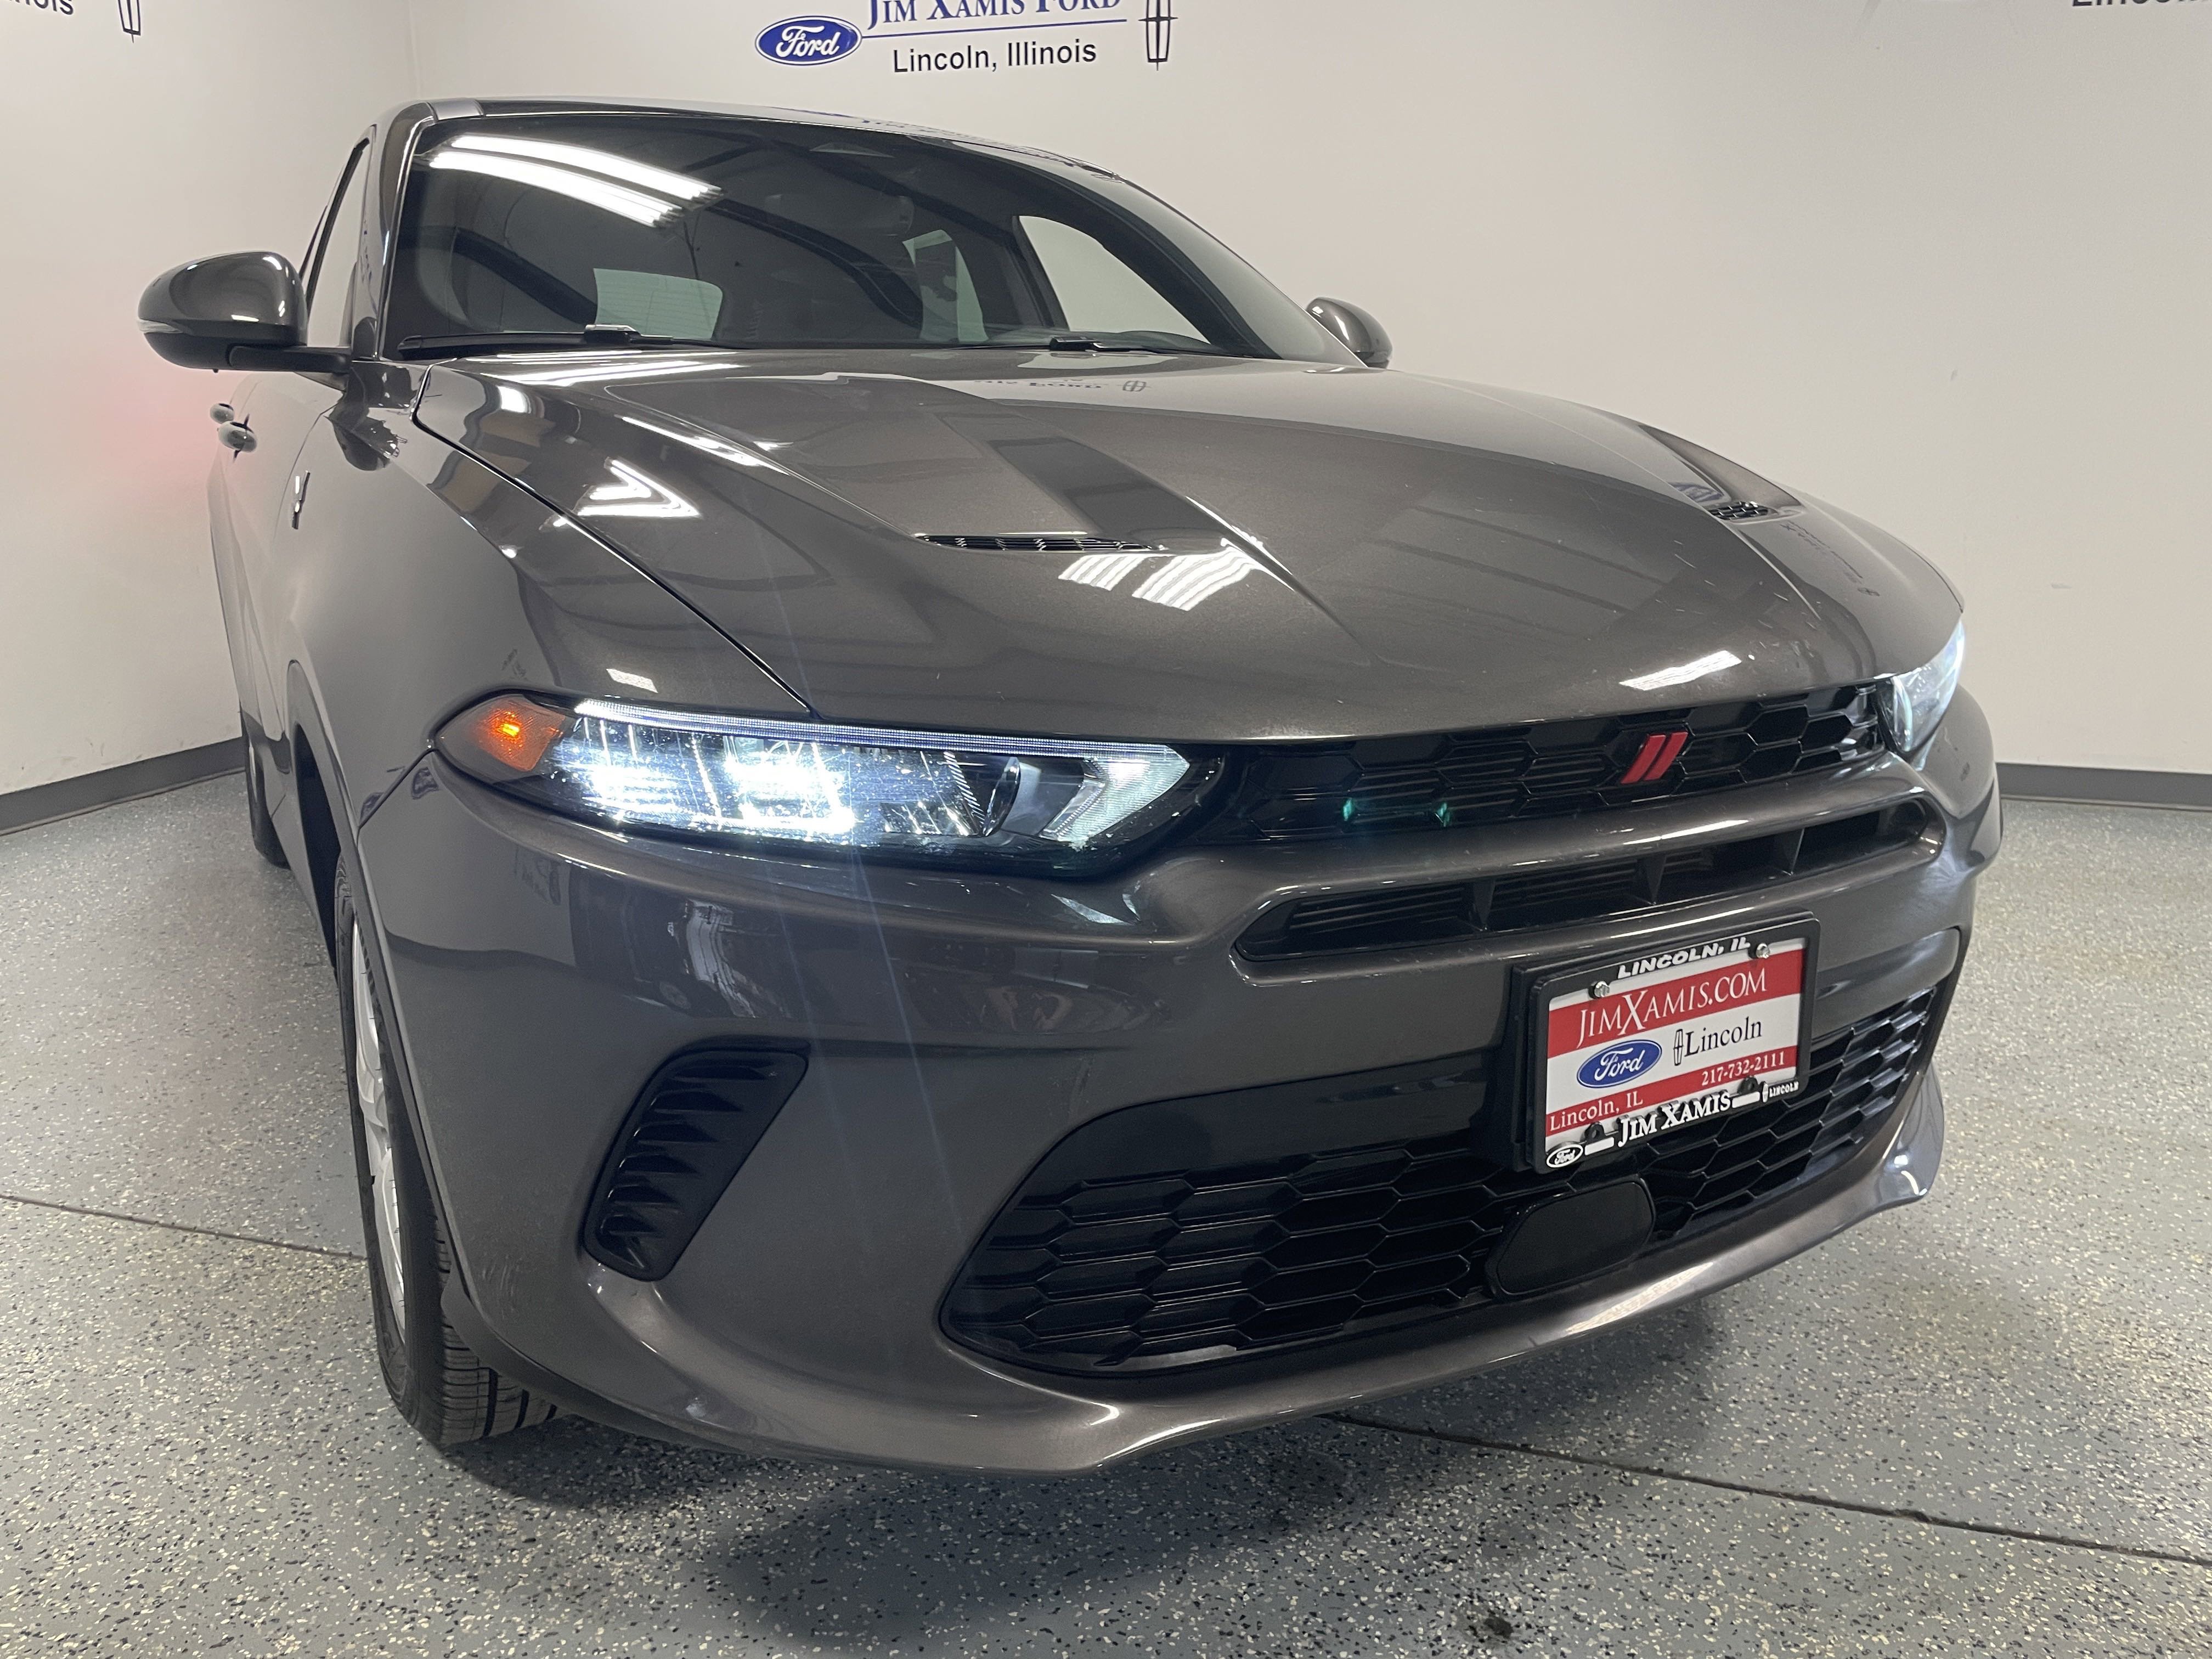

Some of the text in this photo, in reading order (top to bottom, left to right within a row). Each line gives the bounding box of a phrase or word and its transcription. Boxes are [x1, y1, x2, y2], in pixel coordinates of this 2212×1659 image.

[867, 0, 918, 30] JIM
[775, 25, 841, 58] Ford
[893, 38, 1097, 72] Lincoln, Illinois
[1730, 936, 1751, 951] IL
[1576, 967, 1767, 1048] JIMXAMIS.COM
[1684, 1016, 1762, 1057] Lincoln
[1594, 1047, 1645, 1081] Ford
[1701, 1051, 1785, 1086] 217-732-2111
[1769, 1081, 1799, 1098] LINCOLN
[1550, 1091, 1644, 1131] Lincoln, IL
[1618, 1092, 1731, 1147] JIM XAMIS
